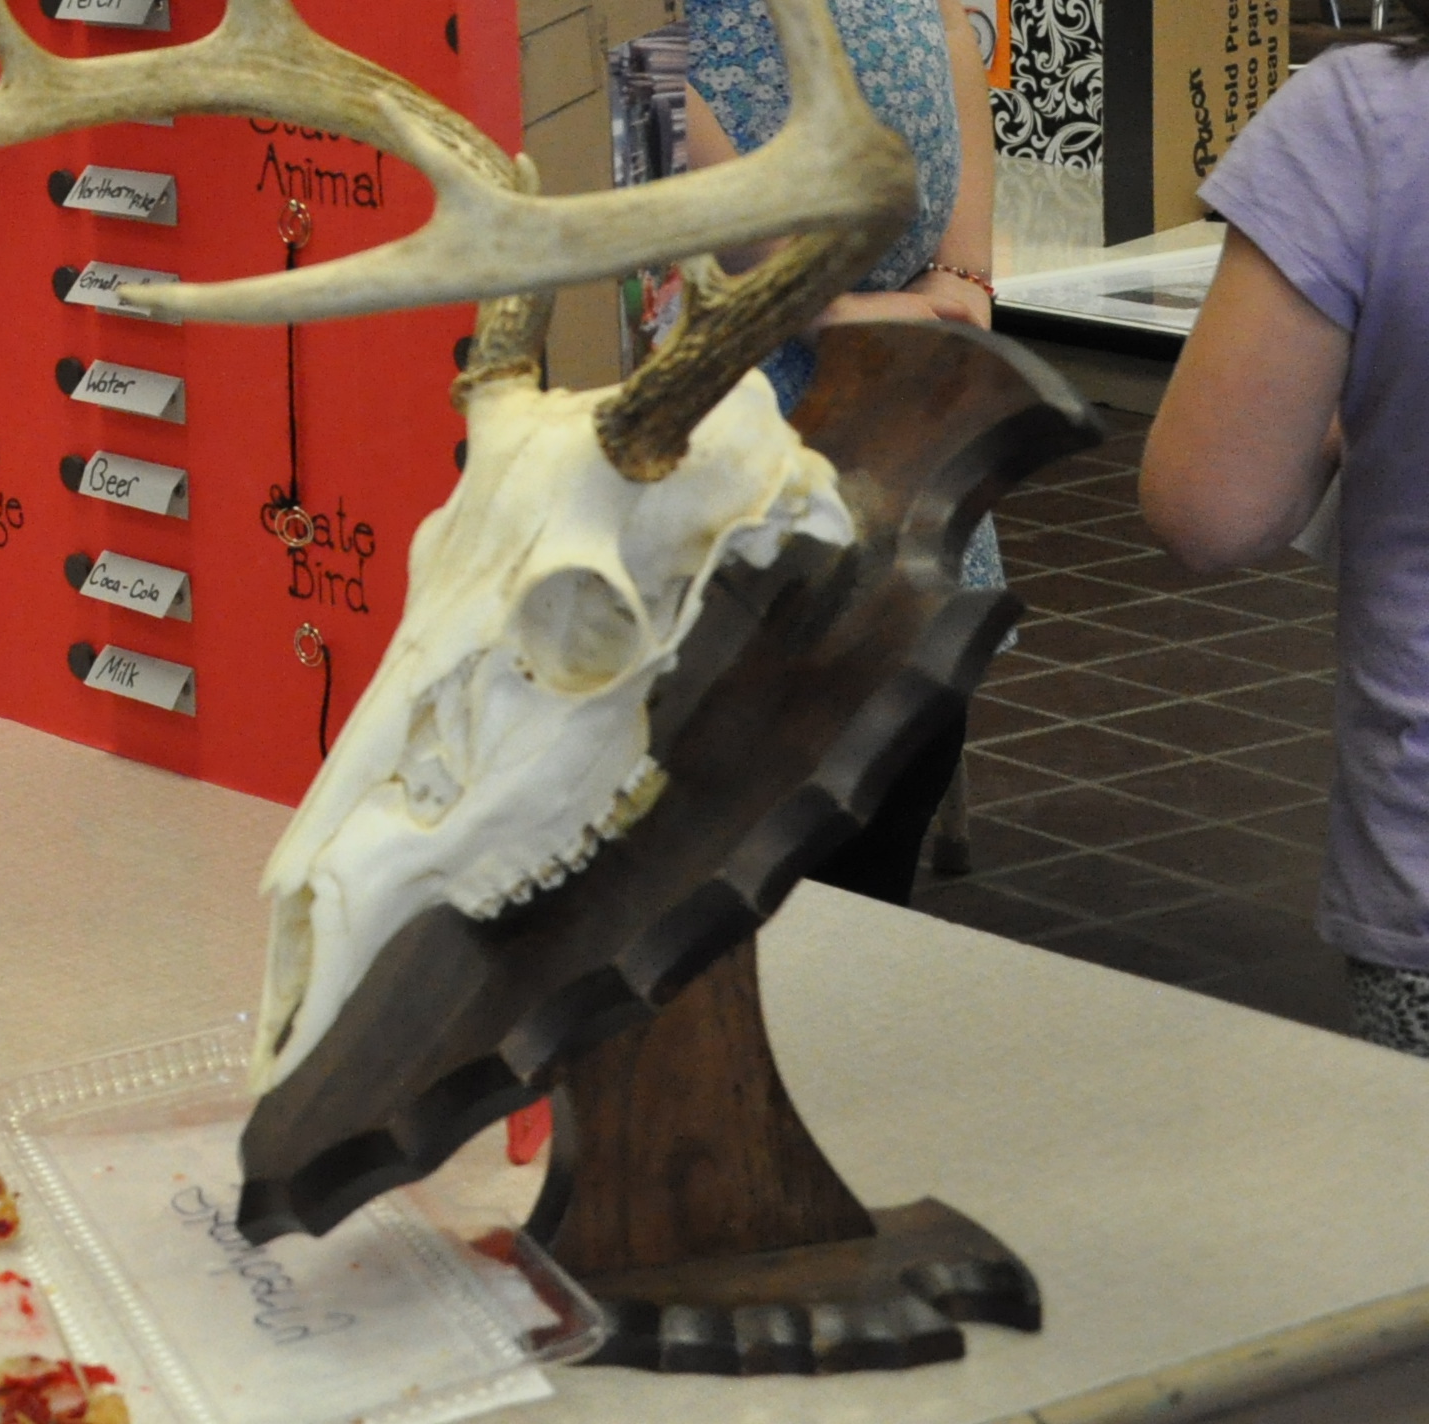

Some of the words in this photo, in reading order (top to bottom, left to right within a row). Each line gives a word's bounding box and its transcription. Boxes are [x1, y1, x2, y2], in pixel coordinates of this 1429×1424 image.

[1188, 67, 1218, 178] Pacon
[256, 142, 384, 209] Animal
[85, 369, 137, 397] Water
[87, 457, 140, 499] Beer
[87, 562, 161, 603] Coca-Cola
[287, 547, 370, 614] Bird
[101, 653, 141, 690] Milk
